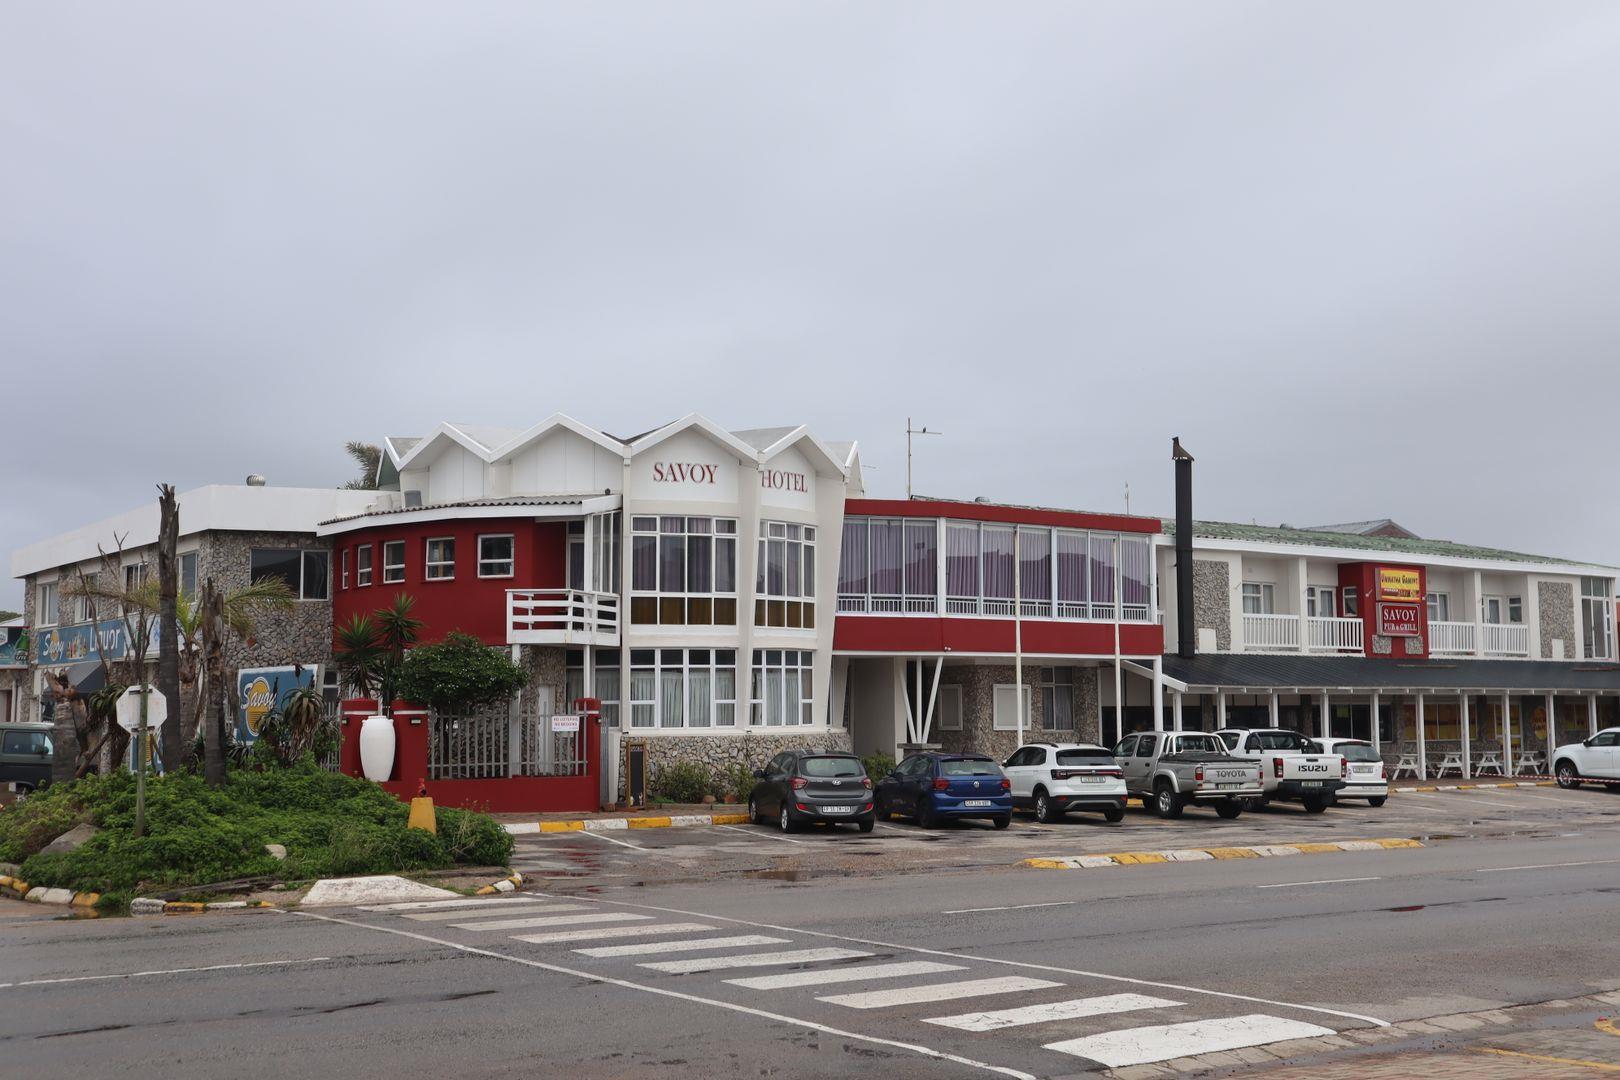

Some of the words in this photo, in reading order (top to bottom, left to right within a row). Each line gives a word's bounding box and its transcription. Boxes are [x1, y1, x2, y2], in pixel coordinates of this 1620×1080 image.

[653, 462, 718, 484] SAVOY
[758, 469, 808, 493] HOTEL
[1384, 608, 1416, 621] SAVOY
[1384, 622, 1396, 631] PUB
[1400, 623, 1417, 631] GRILL
[240, 682, 278, 711] Savoy
[1216, 770, 1247, 778] TOYOTA
